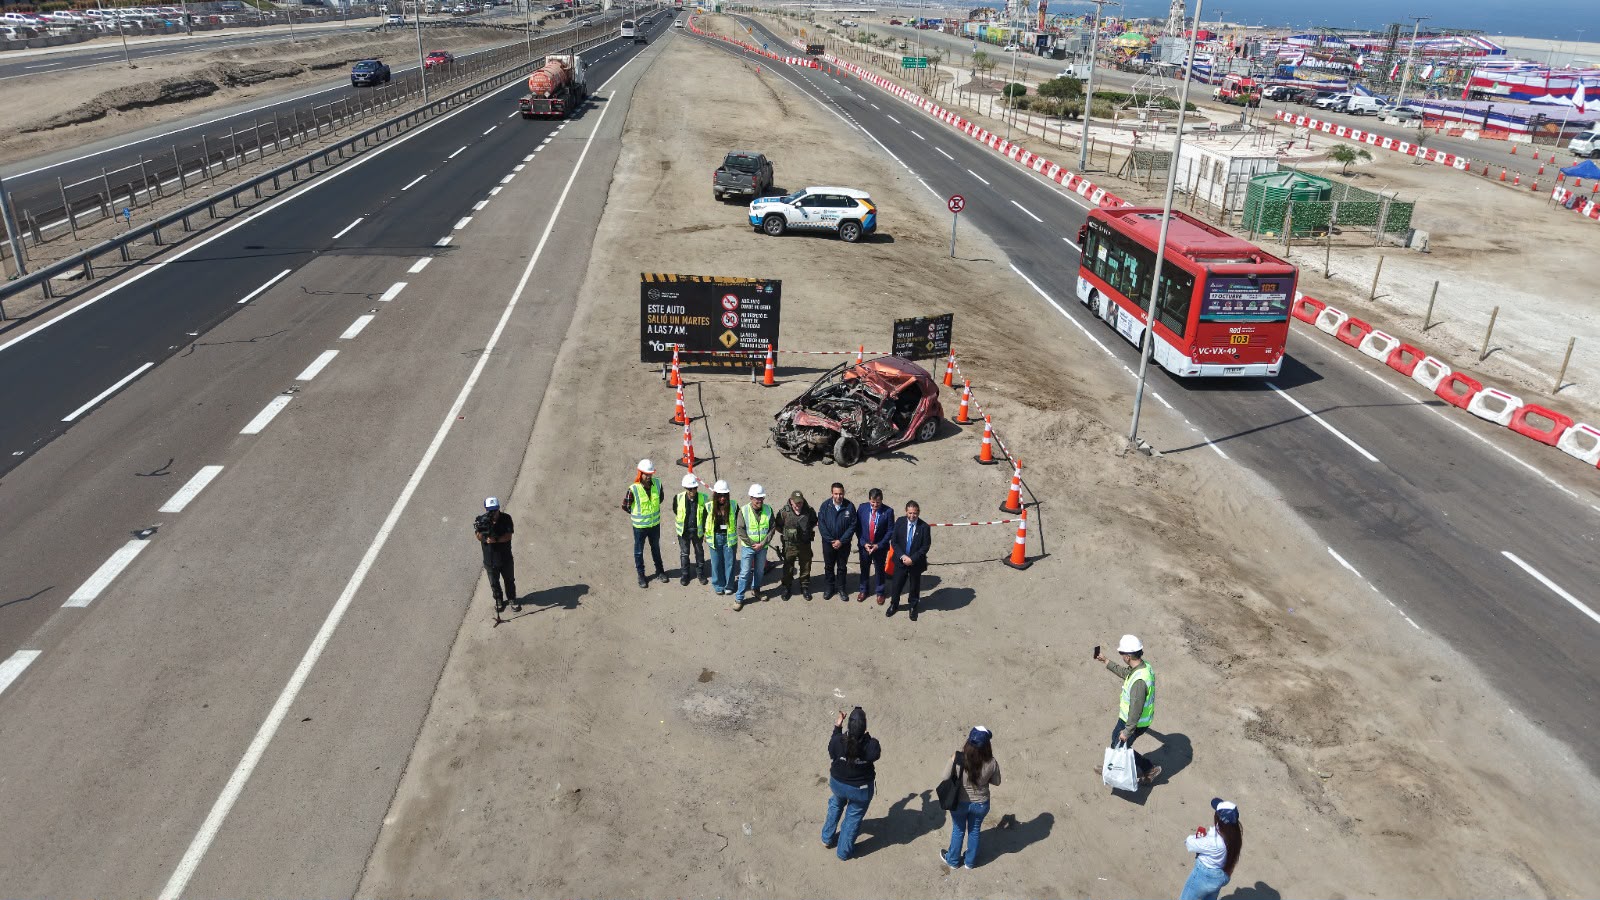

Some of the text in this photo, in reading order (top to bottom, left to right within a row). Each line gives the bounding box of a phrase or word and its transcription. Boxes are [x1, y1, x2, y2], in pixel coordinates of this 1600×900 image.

[1262, 284, 1276, 292] 103
[648, 304, 686, 315] ESTE AUTO
[647, 314, 710, 326] SALIÓ UN MARTES
[647, 325, 653, 334] A
[654, 325, 667, 334] LAS
[668, 325, 674, 335] 7
[1232, 335, 1248, 343] 103
